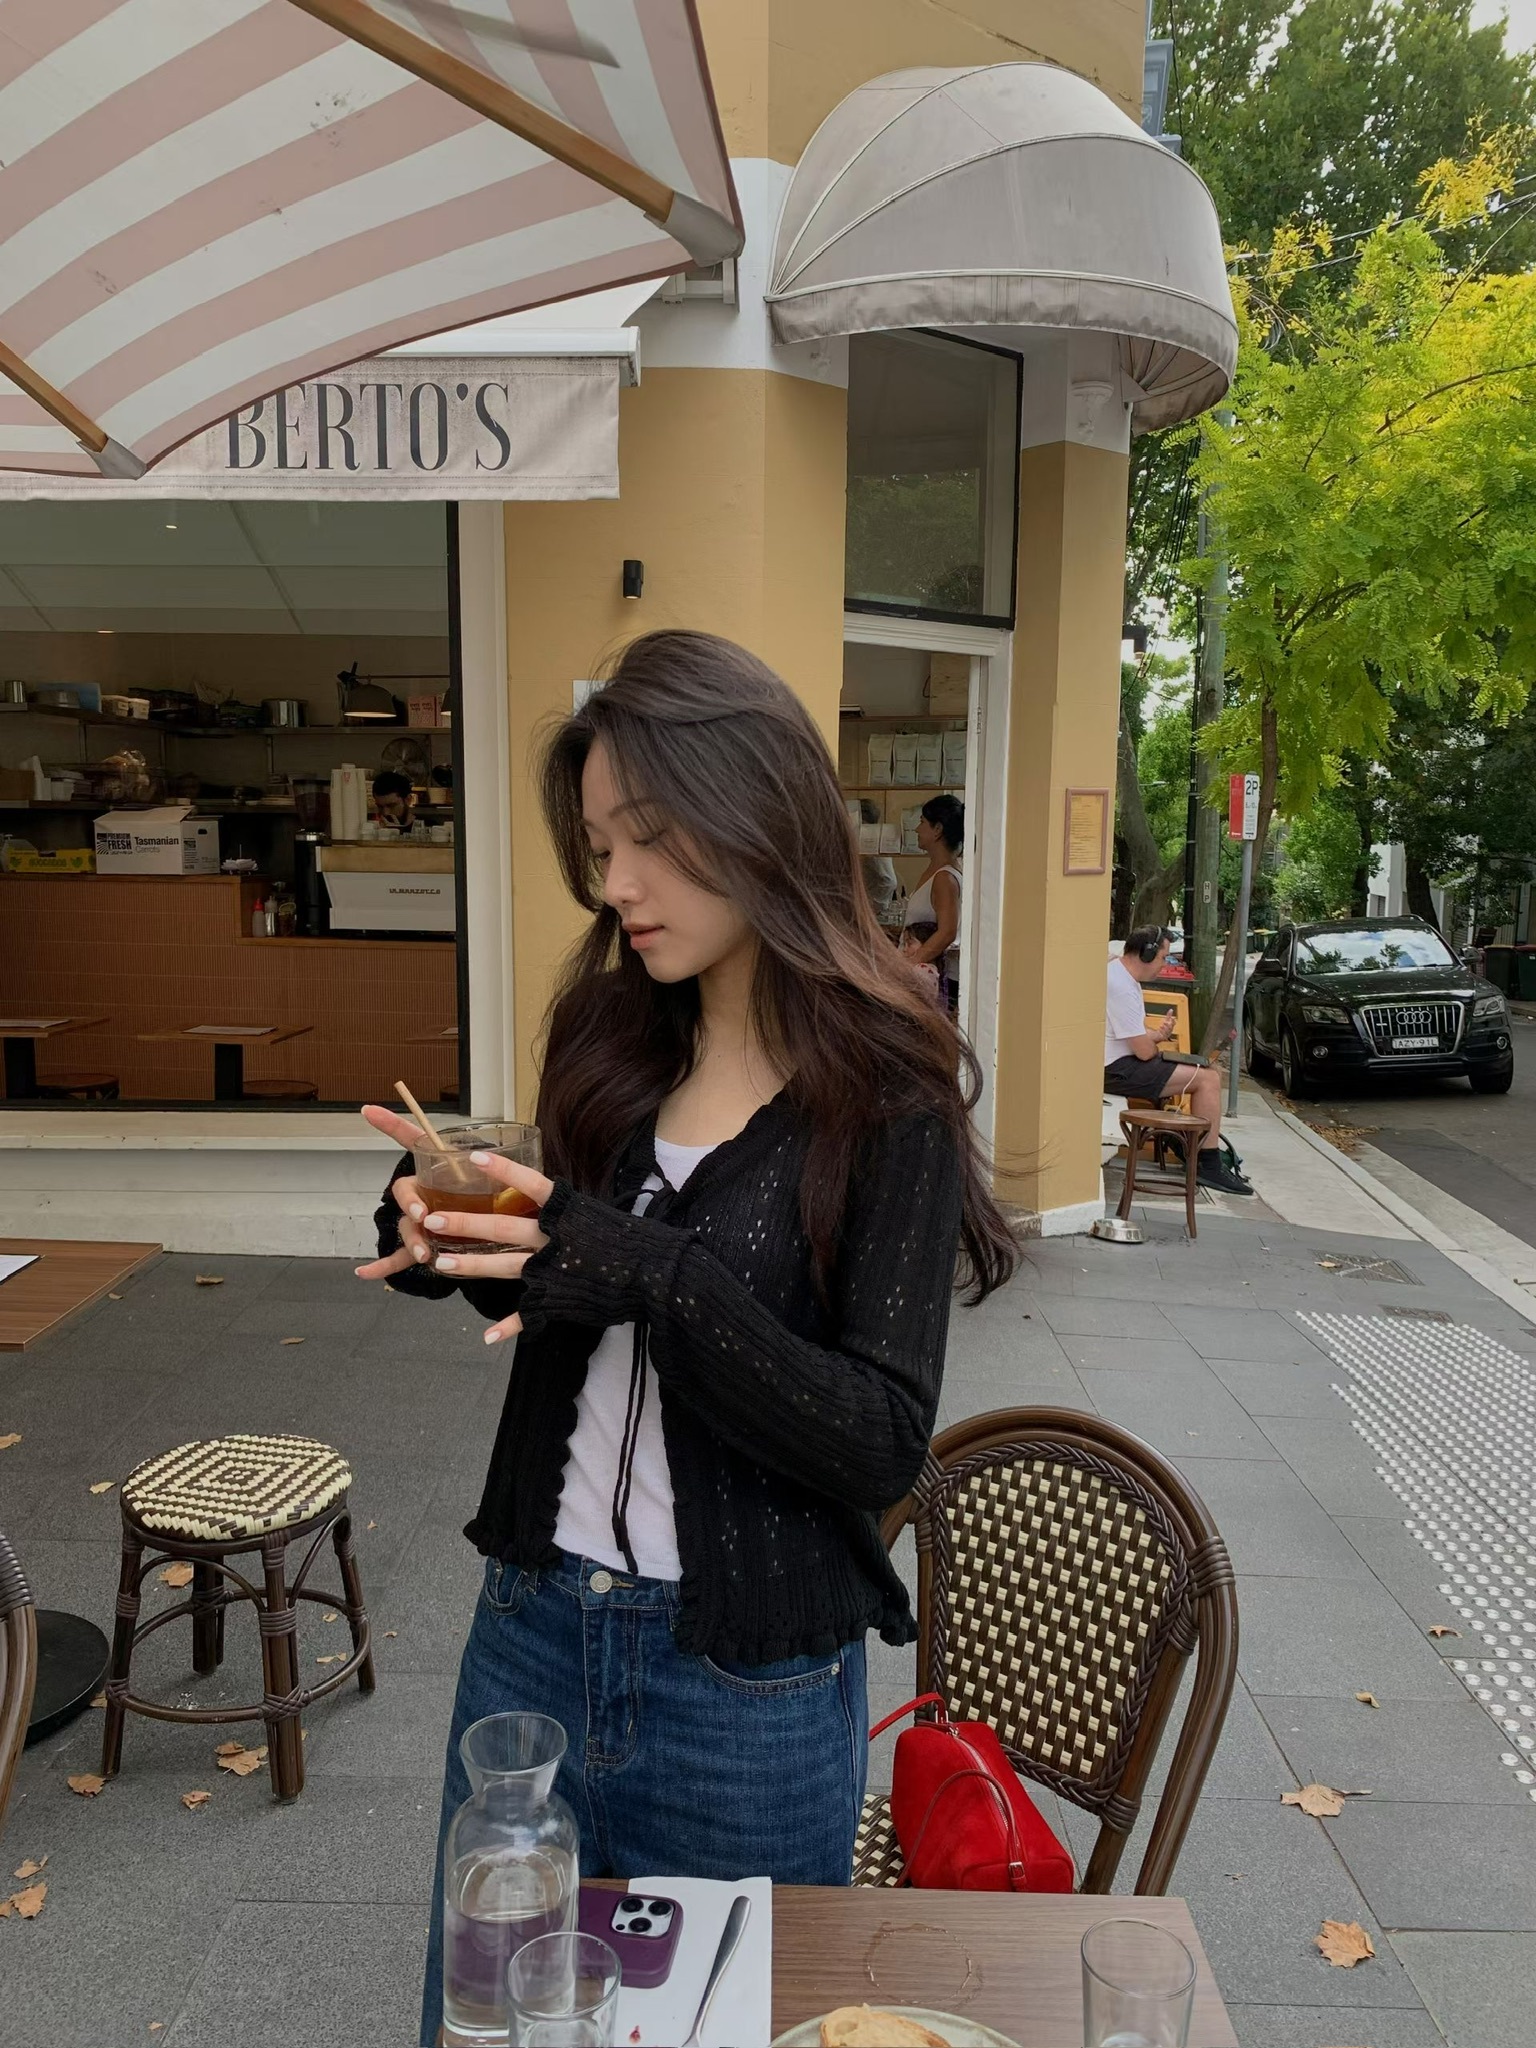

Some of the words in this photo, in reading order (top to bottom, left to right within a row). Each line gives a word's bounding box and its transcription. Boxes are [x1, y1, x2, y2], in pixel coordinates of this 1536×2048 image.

[1245, 780, 1259, 795] 2P
[108, 840, 132, 850] FRESH
[134, 836, 179, 846] Tasmanian
